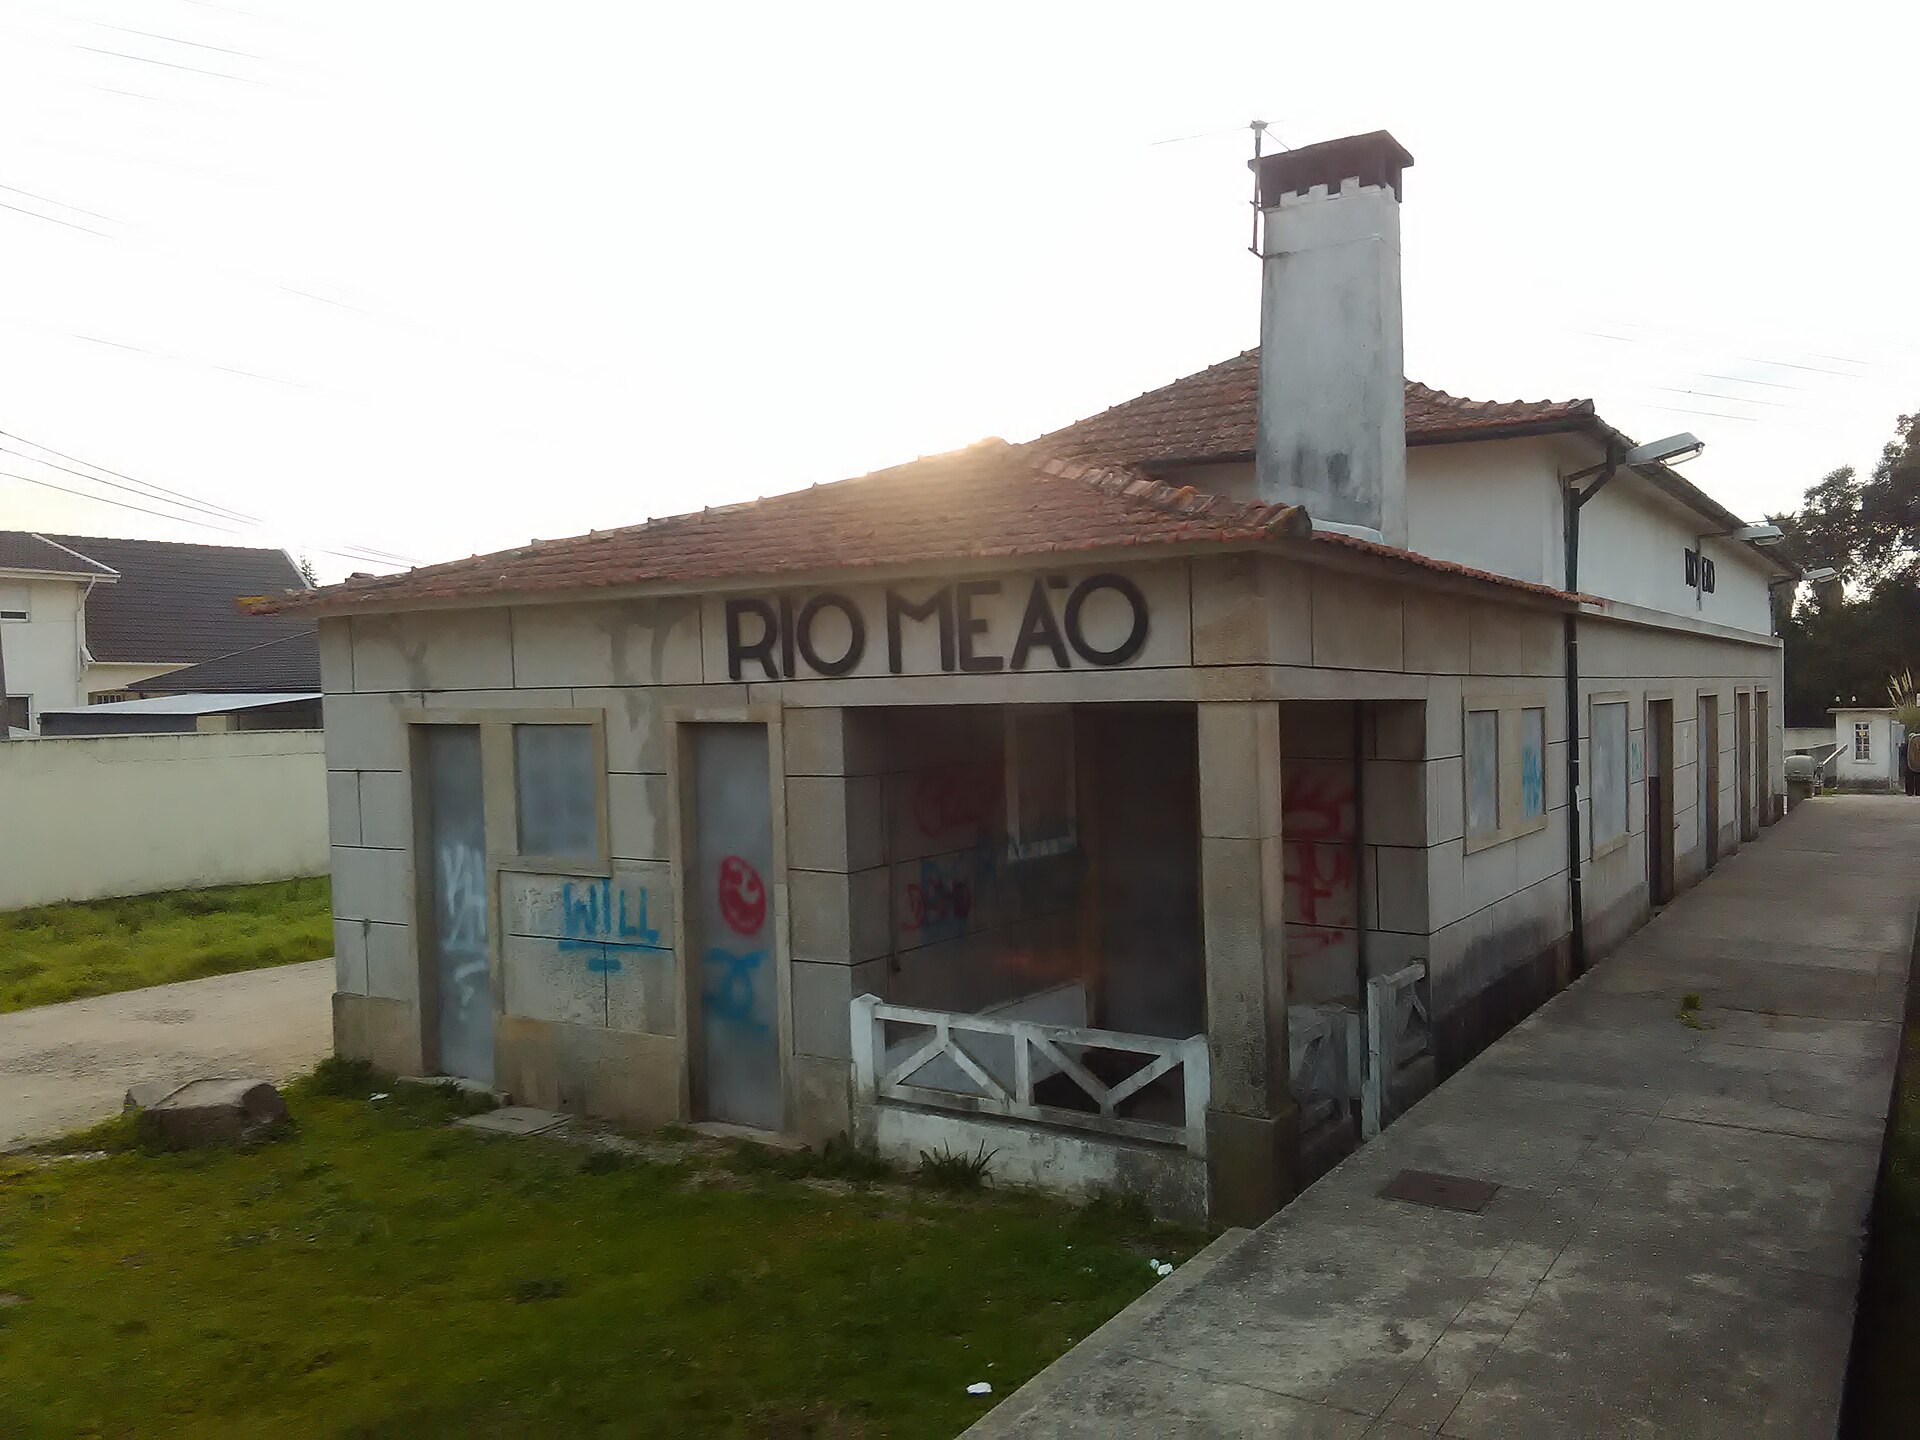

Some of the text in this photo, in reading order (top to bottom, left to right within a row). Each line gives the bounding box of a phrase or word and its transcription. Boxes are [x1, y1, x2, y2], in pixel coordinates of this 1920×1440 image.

[725, 573, 1149, 681] RIO MEÃO
[563, 879, 659, 944] WILL
